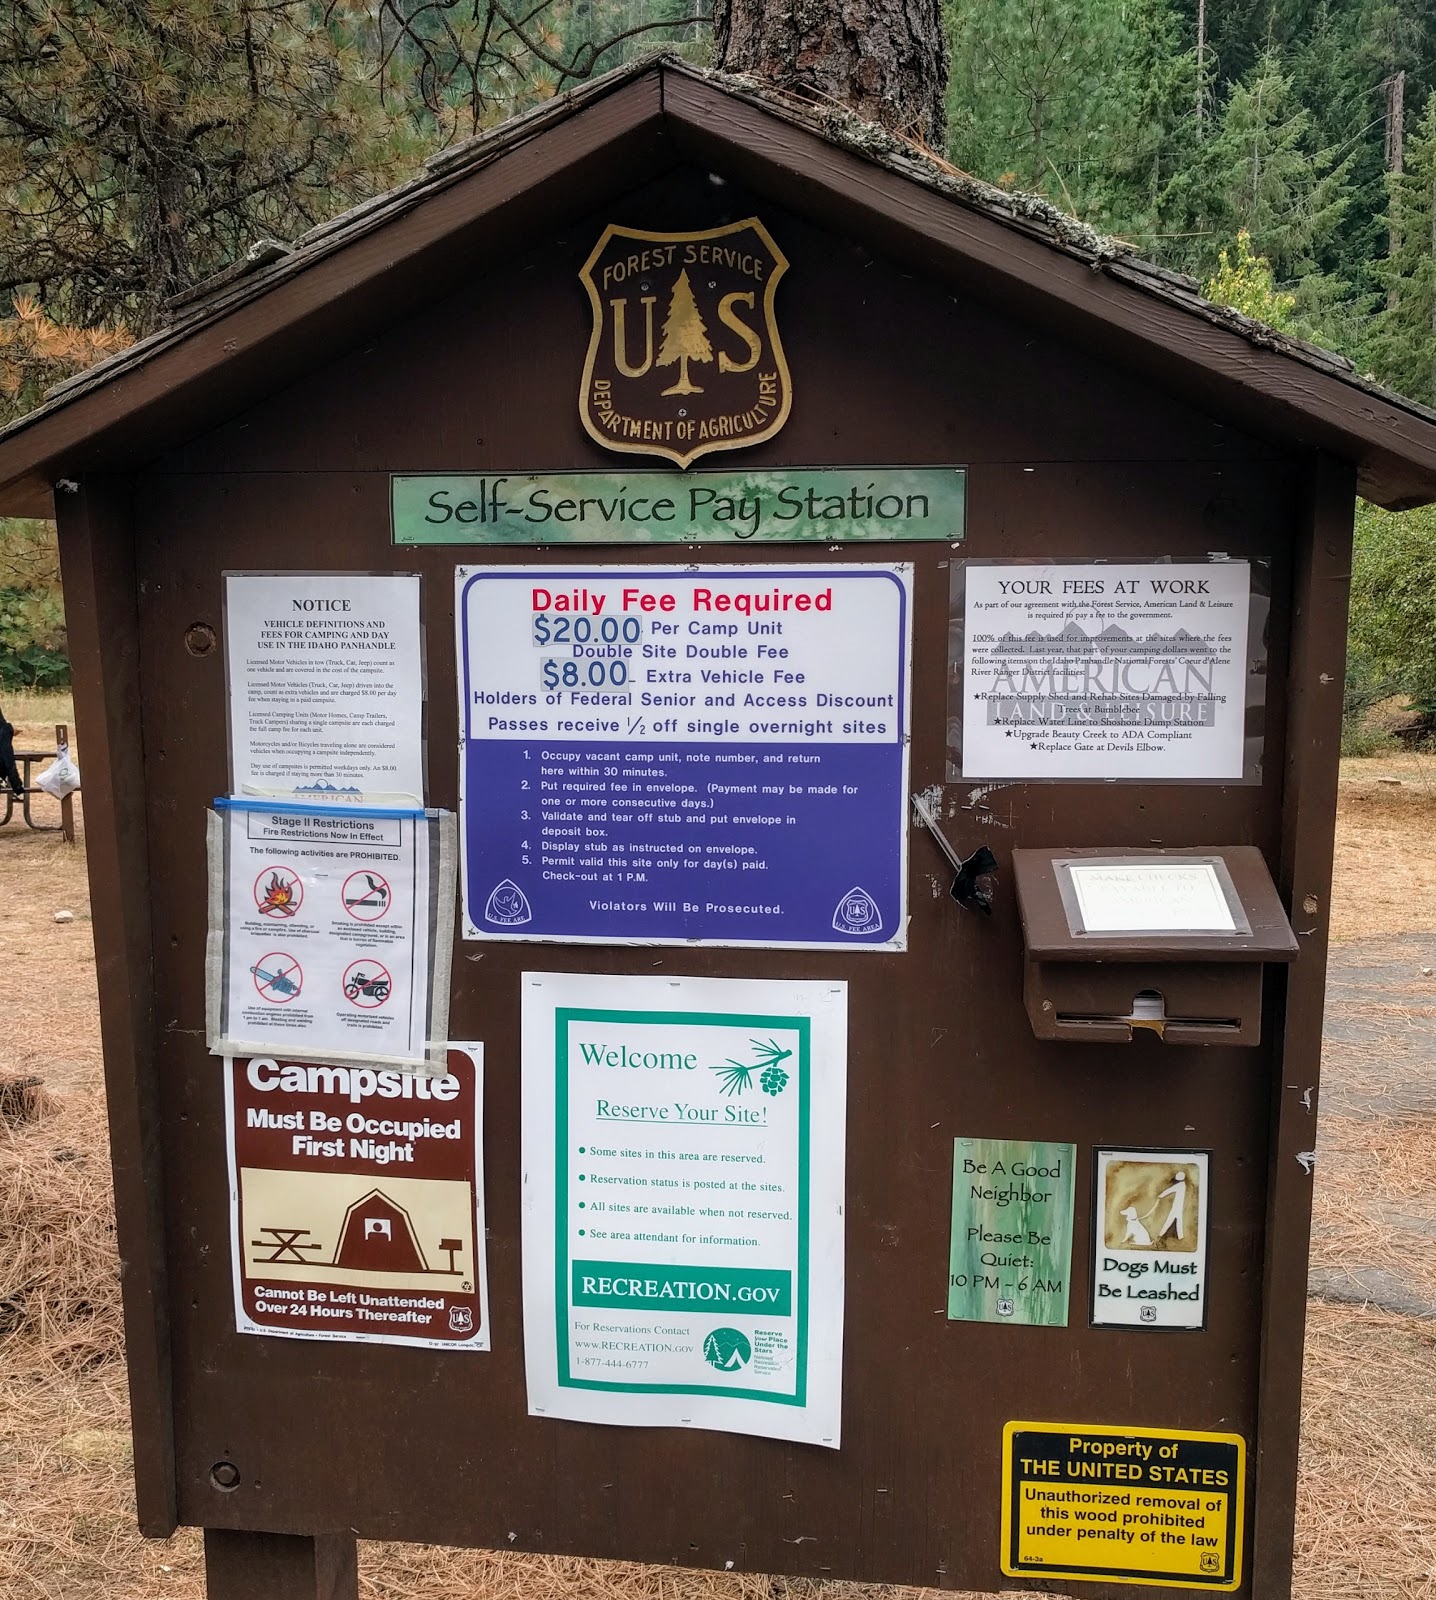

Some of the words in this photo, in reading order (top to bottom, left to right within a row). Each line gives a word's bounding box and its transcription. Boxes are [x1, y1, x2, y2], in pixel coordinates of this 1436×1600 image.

[604, 245, 676, 290] FOREST
[683, 245, 763, 281] SERVICE
[610, 297, 656, 377] U
[718, 292, 762, 373] S
[594, 379, 673, 440] DEPARTMENT
[677, 420, 695, 440] OF
[699, 372, 777, 439] AGRICULTURE
[425, 479, 676, 524] Self-Service
[689, 488, 761, 538] Pay
[773, 484, 929, 520] Station
[998, 580, 1052, 594] YOUR
[1063, 580, 1104, 593] FEES
[1113, 580, 1140, 593] AT
[1149, 580, 1210, 594] WORK
[292, 599, 351, 611] NOTICE
[532, 588, 606, 615] Daily
[623, 588, 675, 611] Fee
[693, 588, 831, 615] Required
[261, 630, 282, 638] FEES
[284, 630, 302, 638] FOR
[306, 620, 364, 628] DEFINITIONS
[367, 620, 386, 628] AND
[534, 614, 640, 645] $20.00
[651, 621, 679, 634] Per
[688, 621, 738, 637] Camp
[748, 621, 782, 634] Unit
[573, 642, 633, 658] Double
[642, 644, 676, 658] Site
[686, 644, 747, 658] Double
[757, 644, 788, 658] Fee
[543, 659, 627, 690] $8.00
[647, 669, 691, 683] Extra
[700, 669, 763, 683] Vehicle
[774, 670, 805, 683] Fee
[474, 691, 536, 705] Holders
[545, 691, 562, 705] of
[571, 691, 631, 705] Federal
[641, 692, 695, 706] Senior
[704, 693, 734, 706] and
[743, 693, 806, 706] Access
[816, 693, 893, 708] Discount
[488, 716, 548, 730] Passes
[557, 718, 619, 731] receive
[653, 718, 677, 732] off
[687, 719, 739, 735] single
[749, 719, 832, 736] overnight
[842, 720, 886, 733] sites
[1013, 729, 1049, 740] Upgrade
[1052, 729, 1080, 740] Beauty
[1082, 729, 1107, 738] Creek
[1121, 730, 1144, 738] ADA
[1147, 730, 1192, 741] Compliant
[523, 751, 531, 760] 1.
[541, 750, 581, 762] Occupy
[585, 752, 620, 760] vacant
[625, 753, 653, 762] camp
[658, 752, 681, 763] unit,
[686, 753, 710, 762] note
[715, 753, 758, 764] number,
[763, 753, 783, 762] and
[788, 754, 820, 762] return
[1038, 742, 1071, 752] Replace
[1074, 742, 1093, 750] Gate
[1107, 742, 1133, 751] Devils
[1136, 742, 1165, 751] Elbow.
[272, 816, 302, 828] Stage
[304, 818, 310, 826] II
[314, 818, 374, 830] Restrictions
[263, 828, 279, 836] Fire
[280, 828, 328, 838] Restrictions
[330, 831, 348, 839] Now
[359, 832, 384, 841] Effect
[265, 847, 298, 856] following
[300, 849, 334, 857] activities
[350, 851, 401, 860] PROHIBITED.
[579, 1043, 696, 1069] Welcome
[246, 1058, 460, 1103] Campsite
[596, 1099, 668, 1119] Reserve
[674, 1103, 718, 1120] Your
[724, 1104, 766, 1123] Site!
[247, 1106, 304, 1130] Must
[310, 1111, 342, 1132] Be
[346, 1112, 460, 1141] Occupied
[292, 1136, 344, 1158] First
[350, 1139, 414, 1164] Night
[962, 1159, 986, 1173] Be
[991, 1160, 1006, 1175] A
[1011, 1160, 1060, 1177] Good
[970, 1183, 1052, 1207] Neighbor
[967, 1224, 1022, 1243] Please
[1027, 1231, 1050, 1245] Be
[980, 1252, 1034, 1267] Quiet:
[1103, 1257, 1148, 1278] Dogs
[1154, 1260, 1197, 1274] Must
[582, 1276, 780, 1302] RECREATION.GOV
[950, 1274, 966, 1287] 10
[972, 1274, 999, 1289] PM
[1017, 1276, 1028, 1290] 6
[1031, 1278, 1061, 1292] AM
[1098, 1284, 1122, 1298] Be
[1127, 1282, 1199, 1301] Leashed
[254, 1286, 304, 1301] Cannot
[307, 1289, 326, 1302] Be
[330, 1290, 356, 1304] Left
[360, 1293, 444, 1310] Unattended
[255, 1300, 288, 1313] Over
[289, 1303, 307, 1315] 24
[310, 1304, 353, 1318] Hours
[355, 1307, 432, 1324] Thereafter
[574, 1321, 591, 1330] For
[593, 1322, 651, 1333] Reservations
[653, 1325, 689, 1335] Contact
[574, 1341, 693, 1352] www.RECREATION.GOV
[576, 1356, 648, 1368] 1-877-444-6777
[1069, 1437, 1152, 1460] Property
[1158, 1443, 1178, 1458] of
[1020, 1458, 1060, 1475] THE
[1067, 1461, 1142, 1479] UNITED
[1149, 1465, 1228, 1485] STATES
[1025, 1488, 1130, 1505] Unauthorized
[1136, 1496, 1200, 1510] removal
[1205, 1499, 1221, 1511] of
[1040, 1506, 1068, 1519] this
[1074, 1510, 1116, 1522] wood
[1122, 1512, 1204, 1528] prohibited
[1026, 1524, 1072, 1536] under
[1077, 1528, 1134, 1544] penalty
[1140, 1530, 1155, 1542] of
[1160, 1531, 1185, 1544] the
[1191, 1533, 1218, 1546] law
